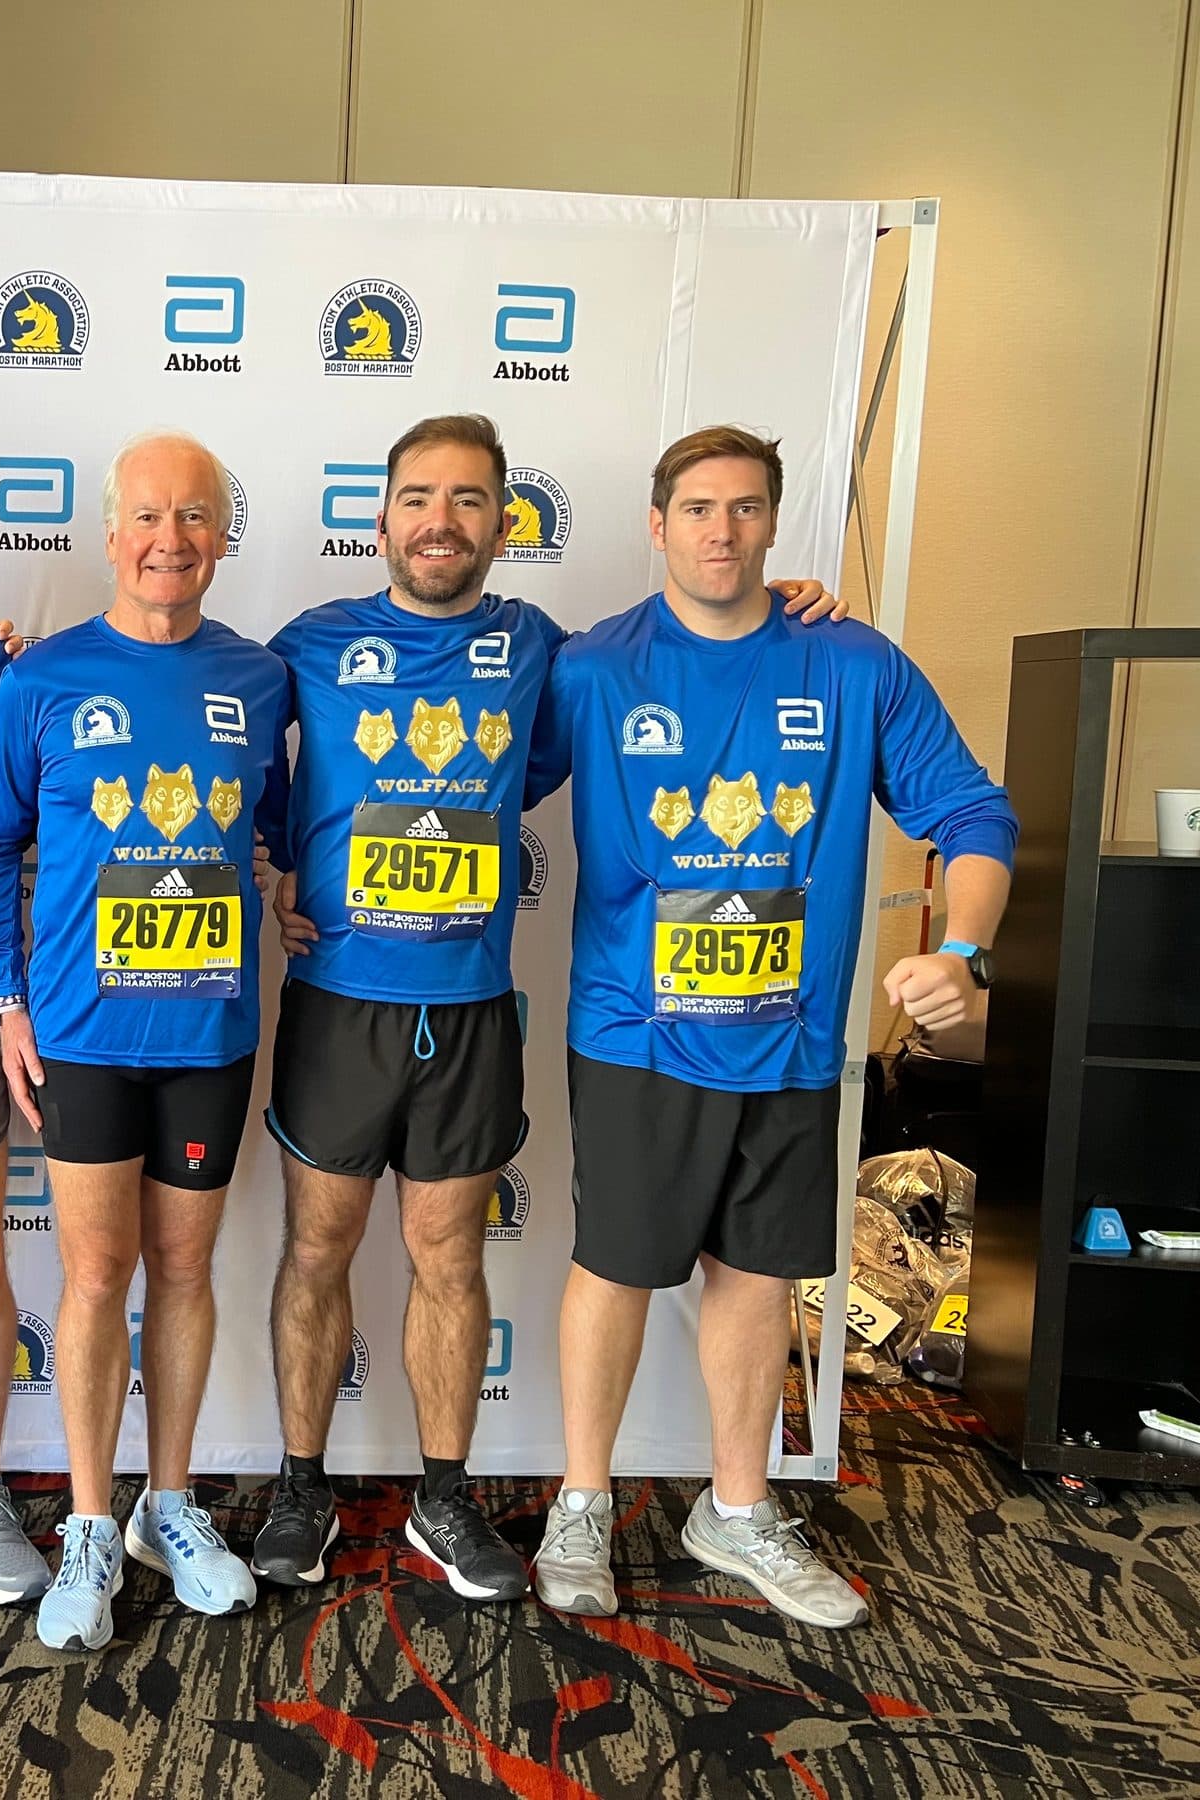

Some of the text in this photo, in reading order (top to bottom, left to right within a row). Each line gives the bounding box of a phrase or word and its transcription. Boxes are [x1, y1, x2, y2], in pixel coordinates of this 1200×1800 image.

[0, 274, 51, 301] ATHLETIC
[51, 278, 87, 347] ASSOCIATION
[323, 282, 420, 355] BOSTON ATHLETIC ASSOCIATION
[31, 355, 83, 367] MARATHON
[164, 353, 242, 373] Abbott
[324, 362, 413, 374] BOSTON MARATHON
[493, 361, 570, 381] Abbott
[228, 480, 244, 535] OCIATION
[505, 470, 570, 541] LETIC ASSOCIATION
[320, 539, 377, 557] Abbo
[513, 550, 563, 560] MARATHON
[471, 667, 511, 678] Abbott
[210, 732, 248, 746] Abbott
[781, 739, 826, 751] Abbott
[375, 779, 488, 793] WOLFPACK
[405, 827, 449, 840] adidas
[113, 846, 224, 861] WOLFPACK
[520, 830, 545, 889] SSOCIATION
[672, 852, 790, 869] WOLFPACK
[363, 841, 479, 895] 29571
[150, 886, 194, 897] adidas
[352, 889, 387, 906] 6 V
[394, 913, 433, 924] BOSTON
[710, 911, 757, 922] adidas
[111, 901, 229, 949] 26779
[372, 918, 434, 931] MARATHON
[669, 926, 790, 975] 29573
[101, 951, 130, 966] 3 V
[122, 979, 183, 988] MARATHON
[143, 972, 182, 980] BOSTON
[660, 975, 699, 990] 6 V
[682, 1005, 746, 1014] MARATHON
[704, 998, 745, 1006] BOSTON
[501, 1164, 527, 1221] SSOCIATION
[3, 1215, 51, 1231] bott
[486, 1229, 522, 1238] RATHON
[24, 1316, 55, 1374] ASSOCIATION
[11, 1383, 52, 1392] ARATHON
[480, 1385, 510, 1401] ott
